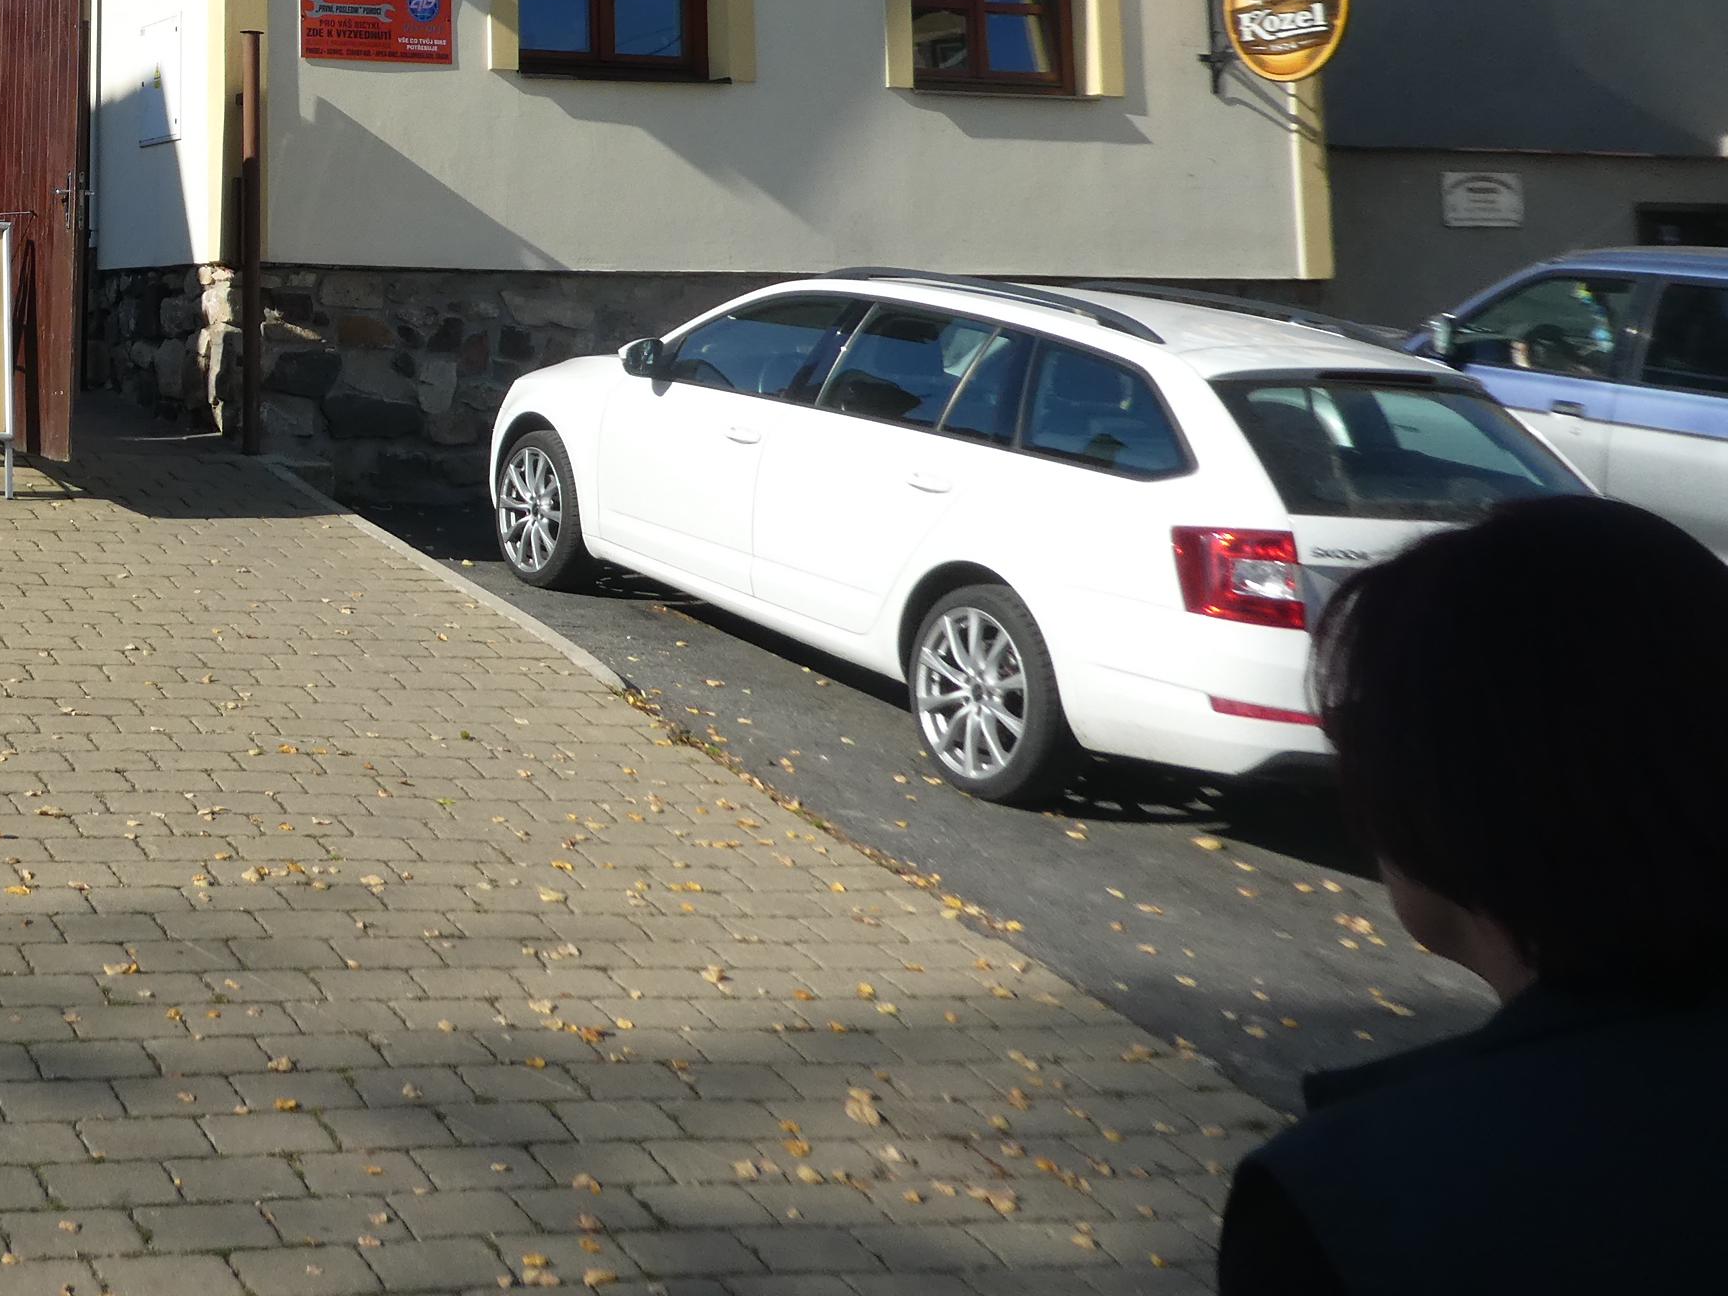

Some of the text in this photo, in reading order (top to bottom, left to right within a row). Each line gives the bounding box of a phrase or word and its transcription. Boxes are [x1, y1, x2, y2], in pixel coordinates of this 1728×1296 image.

[306, 28, 324, 38] ZDE
[327, 29, 334, 38] K
[1237, 3, 1329, 43] Kozel
